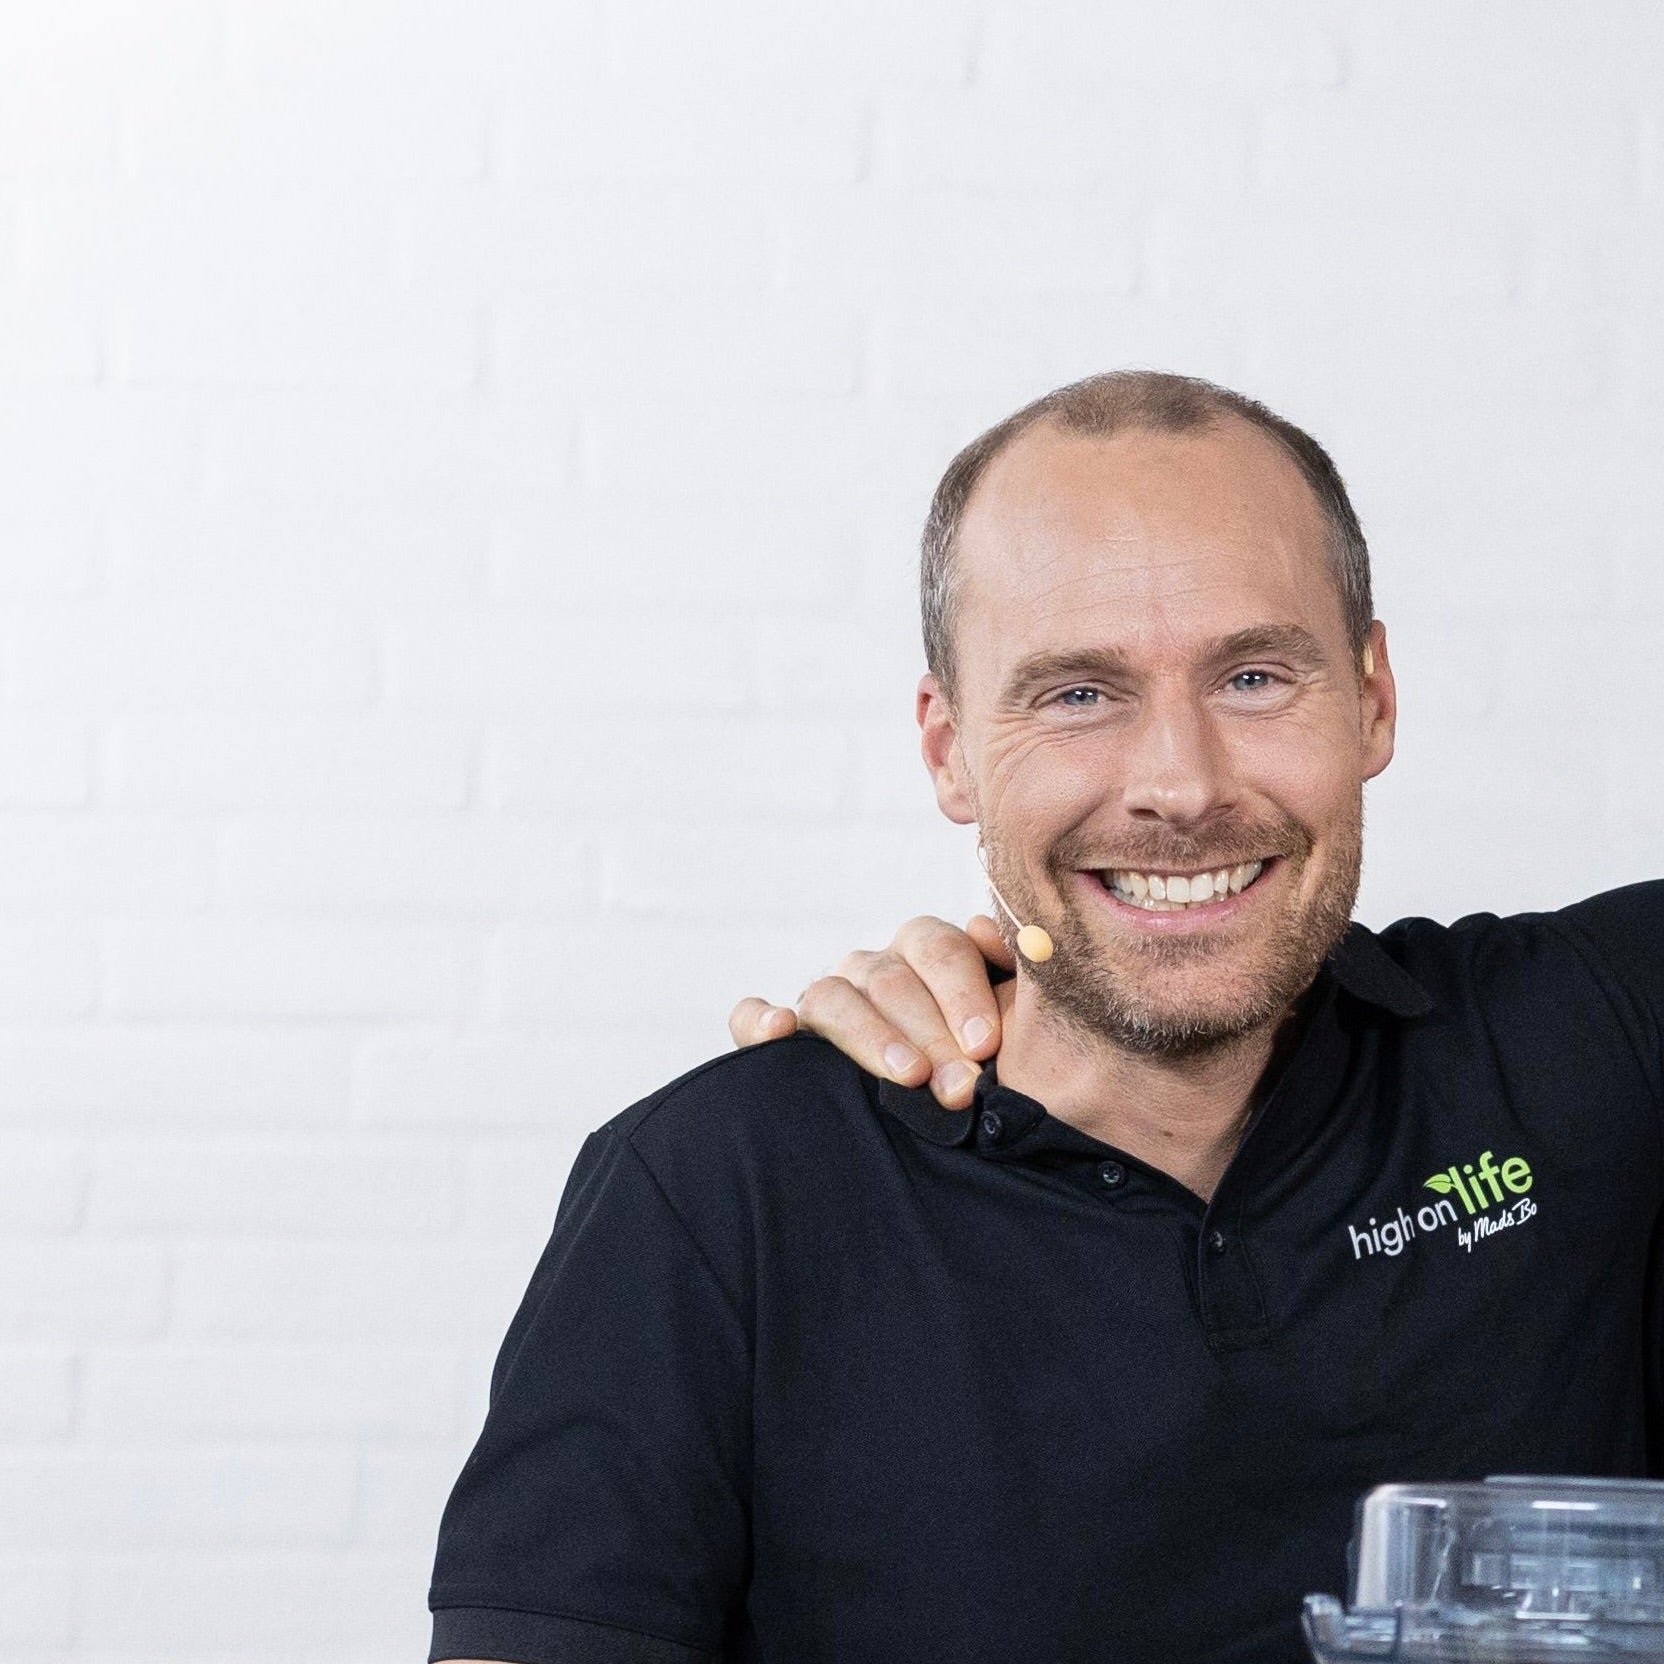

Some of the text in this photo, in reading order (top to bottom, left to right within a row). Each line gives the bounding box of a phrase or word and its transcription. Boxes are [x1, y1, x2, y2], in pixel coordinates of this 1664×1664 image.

[1348, 1151, 1533, 1260] high on life
[1458, 1197, 1538, 1254] by Mads Bo
